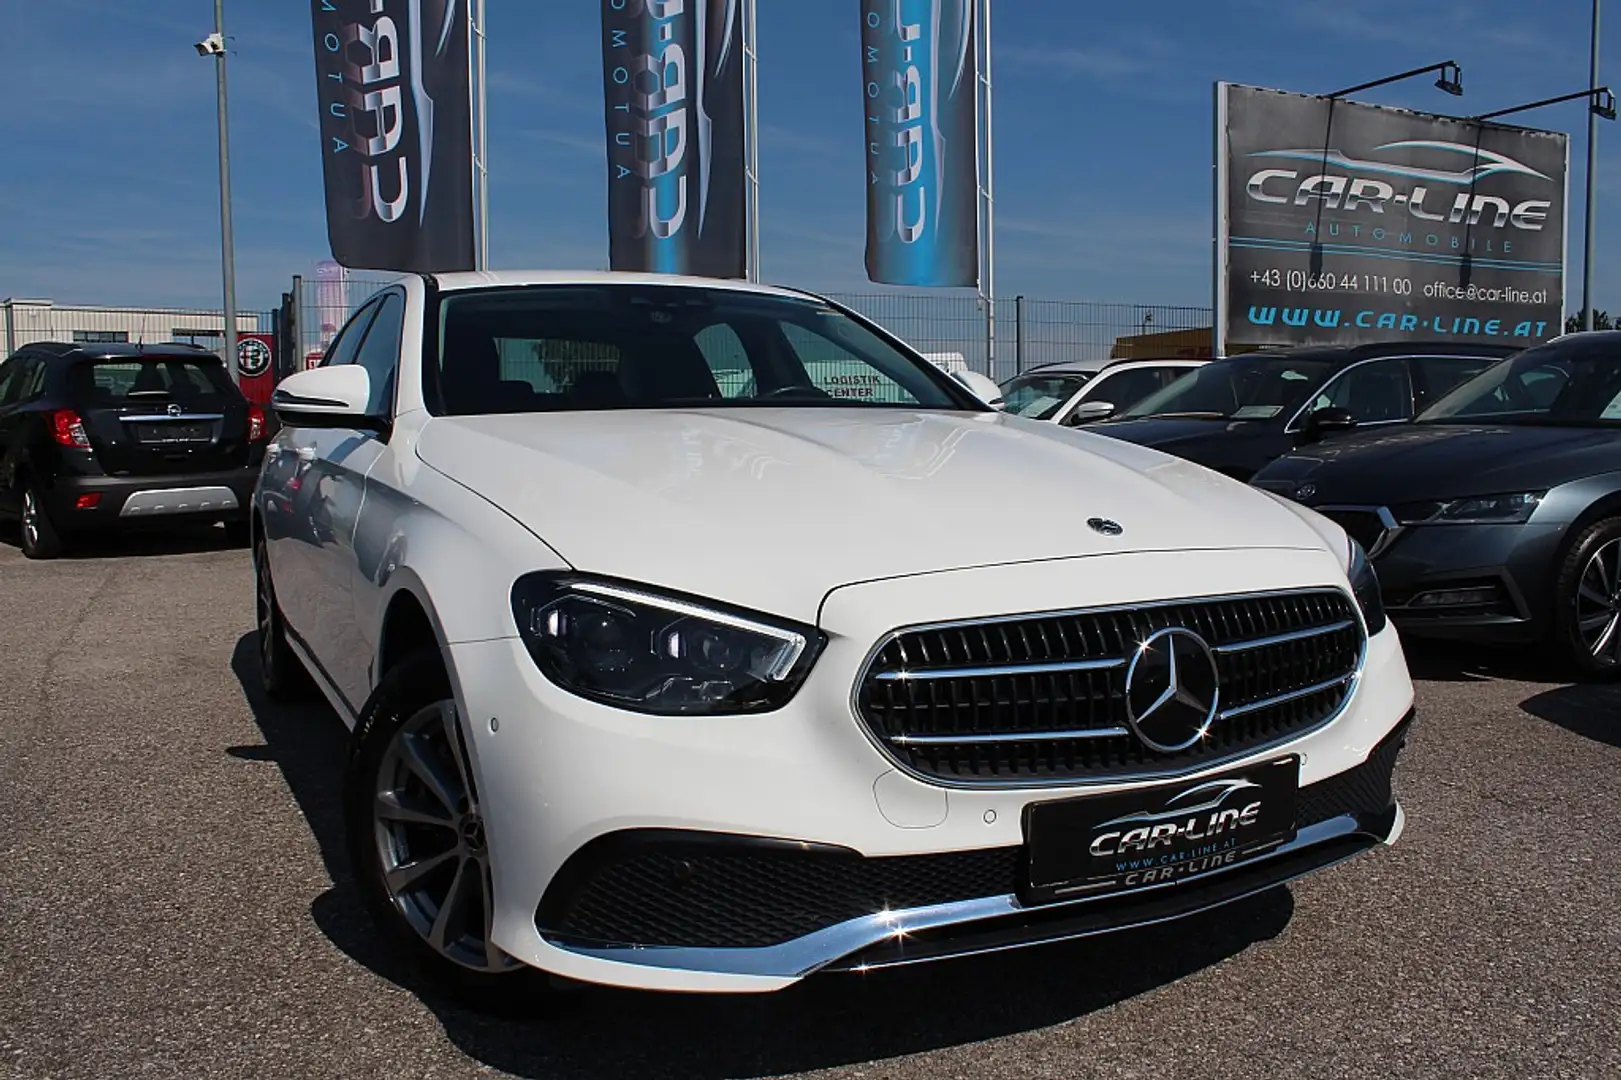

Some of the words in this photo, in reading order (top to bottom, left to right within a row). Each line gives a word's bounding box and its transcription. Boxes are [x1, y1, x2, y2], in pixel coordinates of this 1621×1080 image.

[1245, 169, 1552, 232] CAR-LINE
[1304, 221, 1513, 253] AUTOMOBILE
[1250, 269, 1281, 287] +43
[1286, 270, 1336, 292] (0)660
[1340, 274, 1358, 290] 44
[1364, 275, 1388, 292] 111
[1393, 278, 1412, 296] 00
[1423, 281, 1547, 304] office@car-line.at
[824, 375, 880, 385] LOGISTIK
[826, 387, 873, 398] CENTER
[1089, 801, 1262, 857] CAR-LINE
